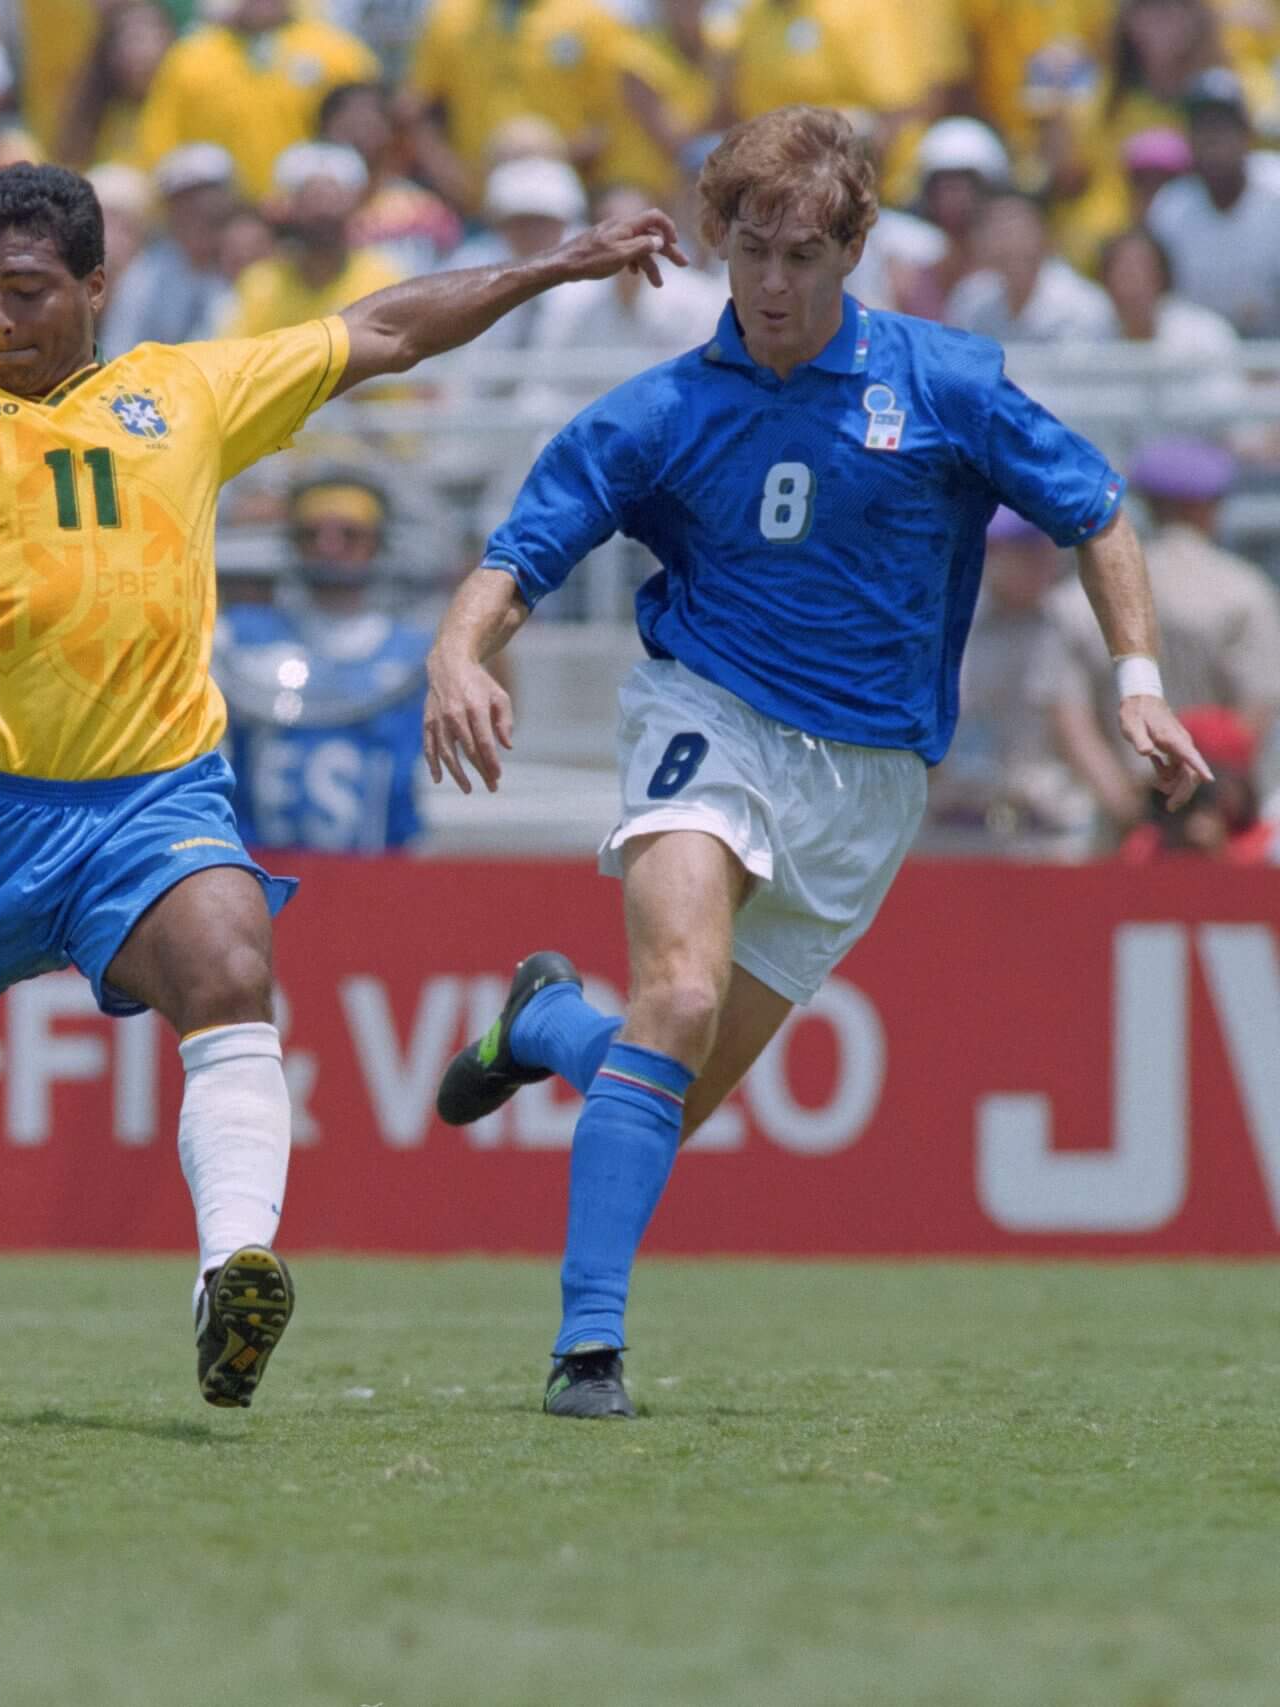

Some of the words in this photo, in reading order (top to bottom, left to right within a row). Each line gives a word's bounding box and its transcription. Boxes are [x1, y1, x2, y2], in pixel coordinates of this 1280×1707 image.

[43, 446, 121, 530] 11
[759, 462, 815, 544] 8
[646, 731, 710, 800] 8
